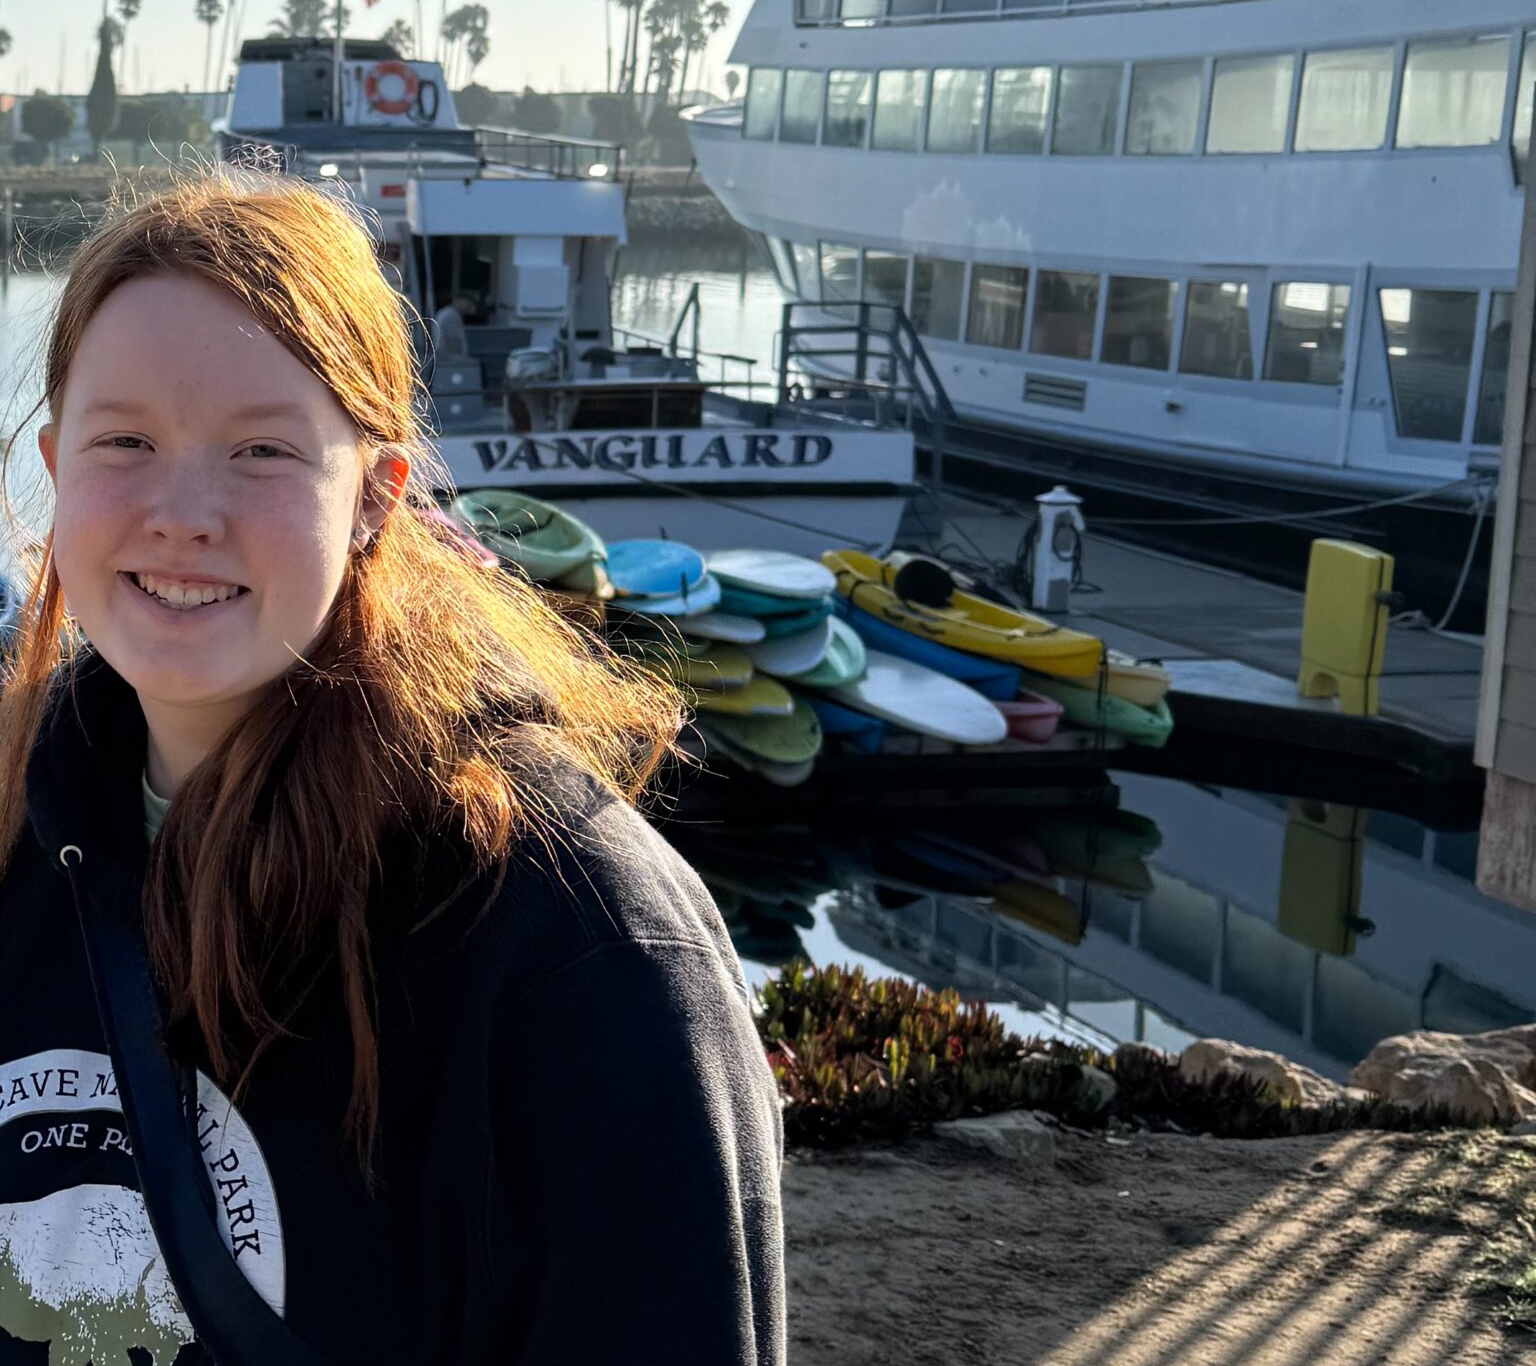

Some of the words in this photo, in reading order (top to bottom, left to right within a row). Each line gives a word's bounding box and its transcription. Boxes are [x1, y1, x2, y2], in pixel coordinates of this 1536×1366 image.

[472, 433, 834, 473] VANGUARD
[20, 1122, 88, 1154] ONE
[210, 1147, 262, 1261] PARK
